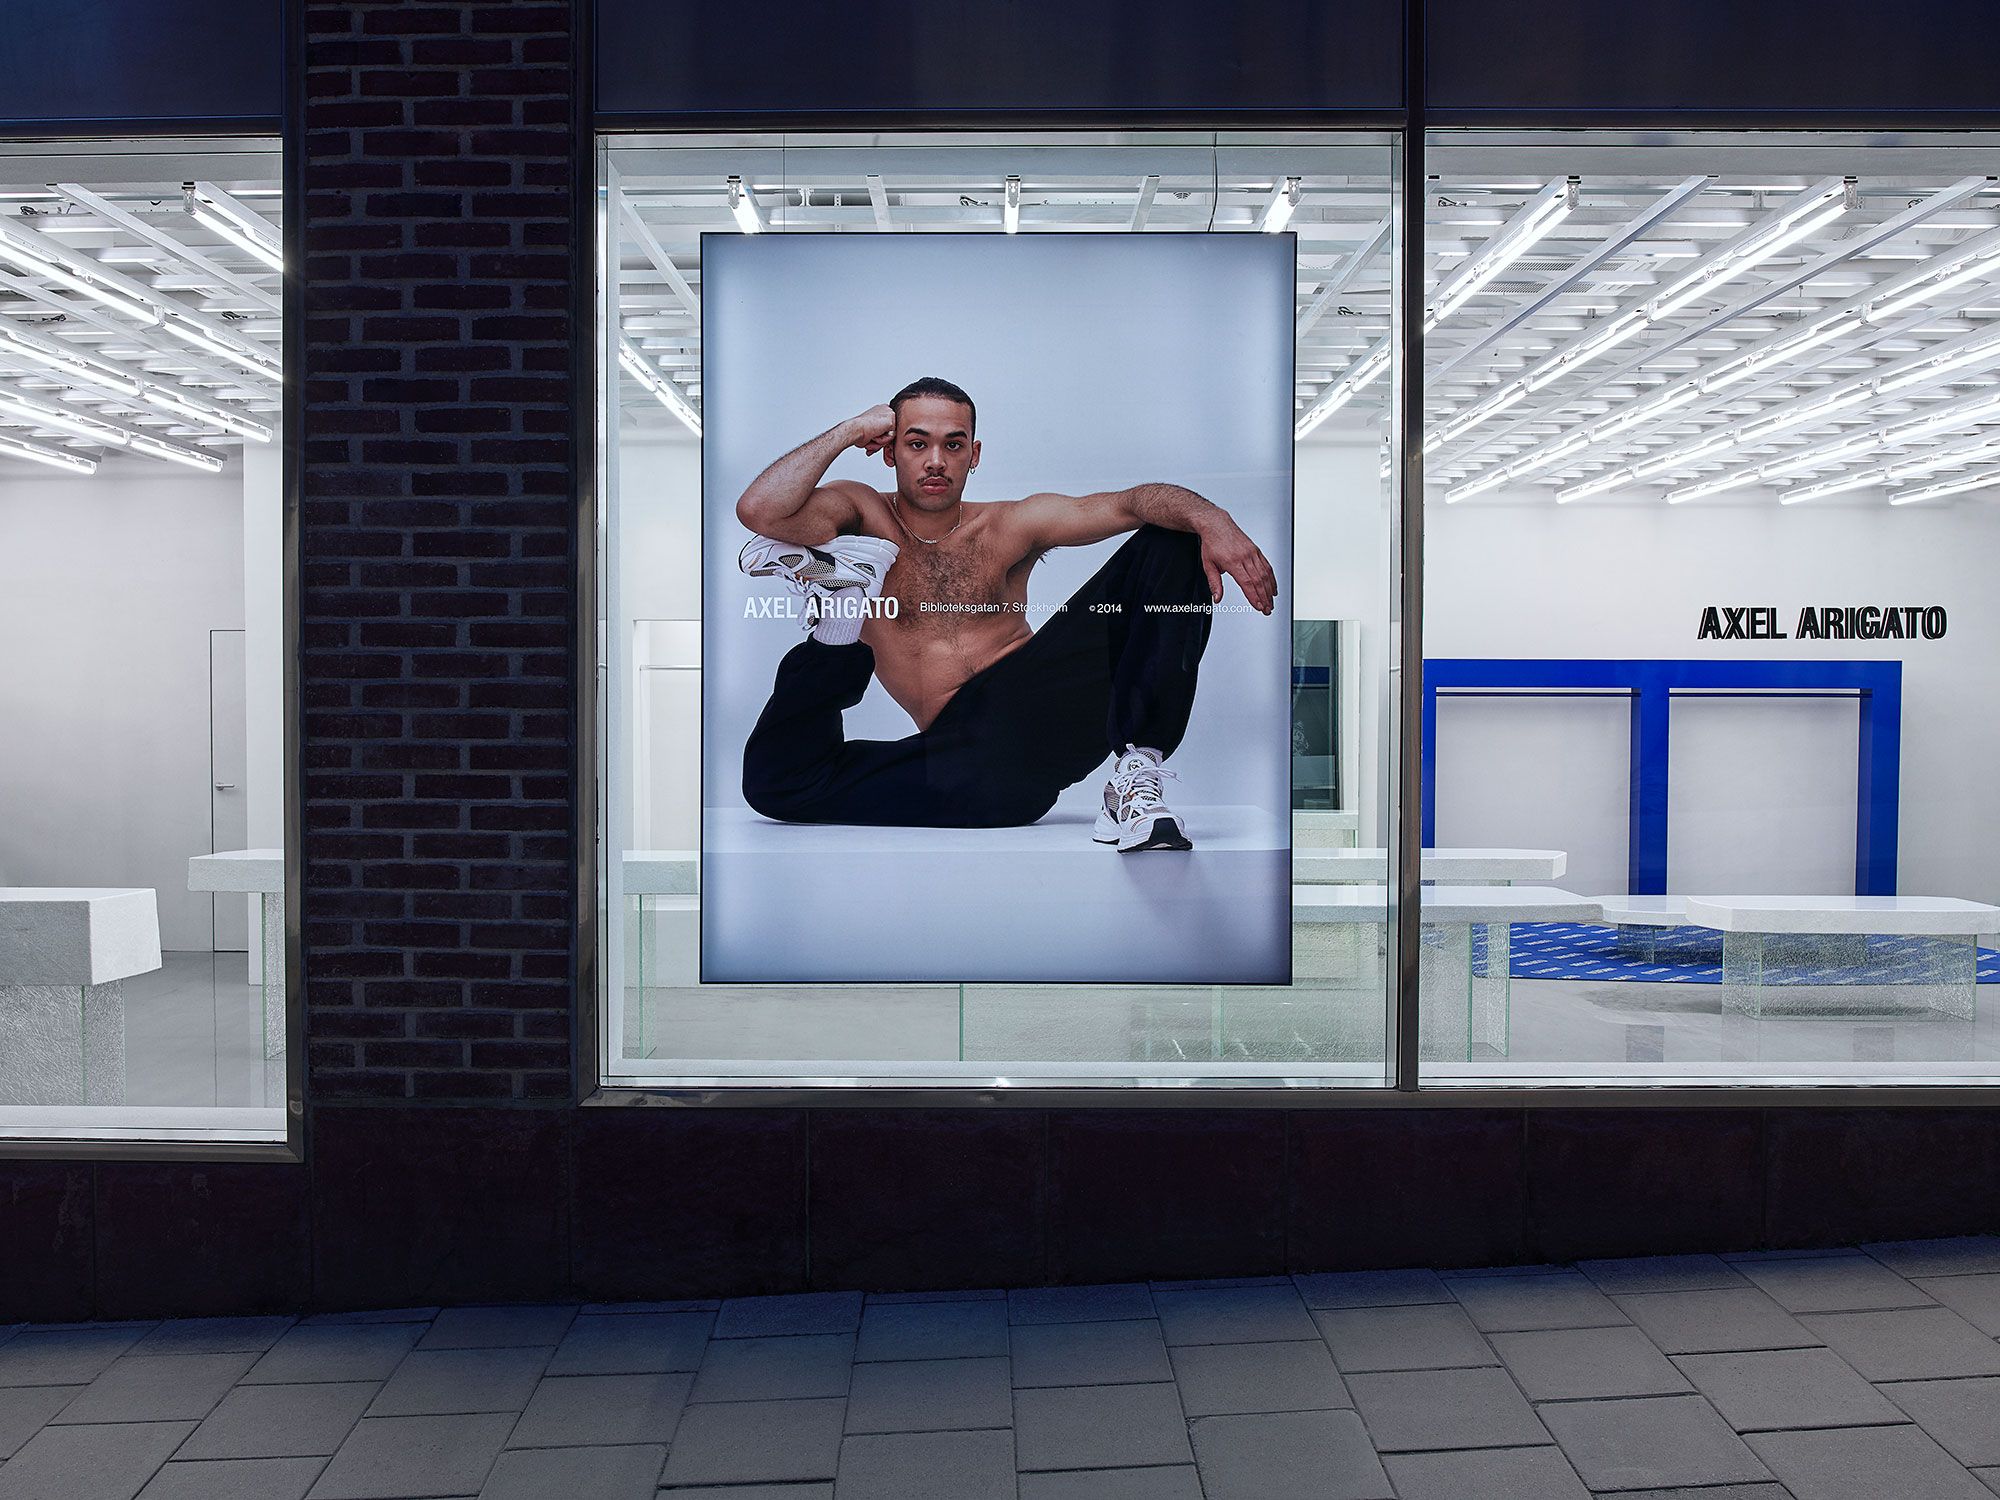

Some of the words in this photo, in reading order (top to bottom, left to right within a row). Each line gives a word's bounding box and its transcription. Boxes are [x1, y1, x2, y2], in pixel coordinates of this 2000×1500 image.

[743, 596, 798, 619] AXEL
[805, 596, 900, 619] ARIGATO
[919, 602, 1000, 614] Biblioteksgatan
[1002, 602, 1010, 613] 7,
[1012, 602, 1068, 613] Stockholm
[1143, 603, 1253, 615] www.axelarigato.com
[1697, 606, 1788, 640] AXEL
[1795, 605, 1948, 640] ARIGATO
